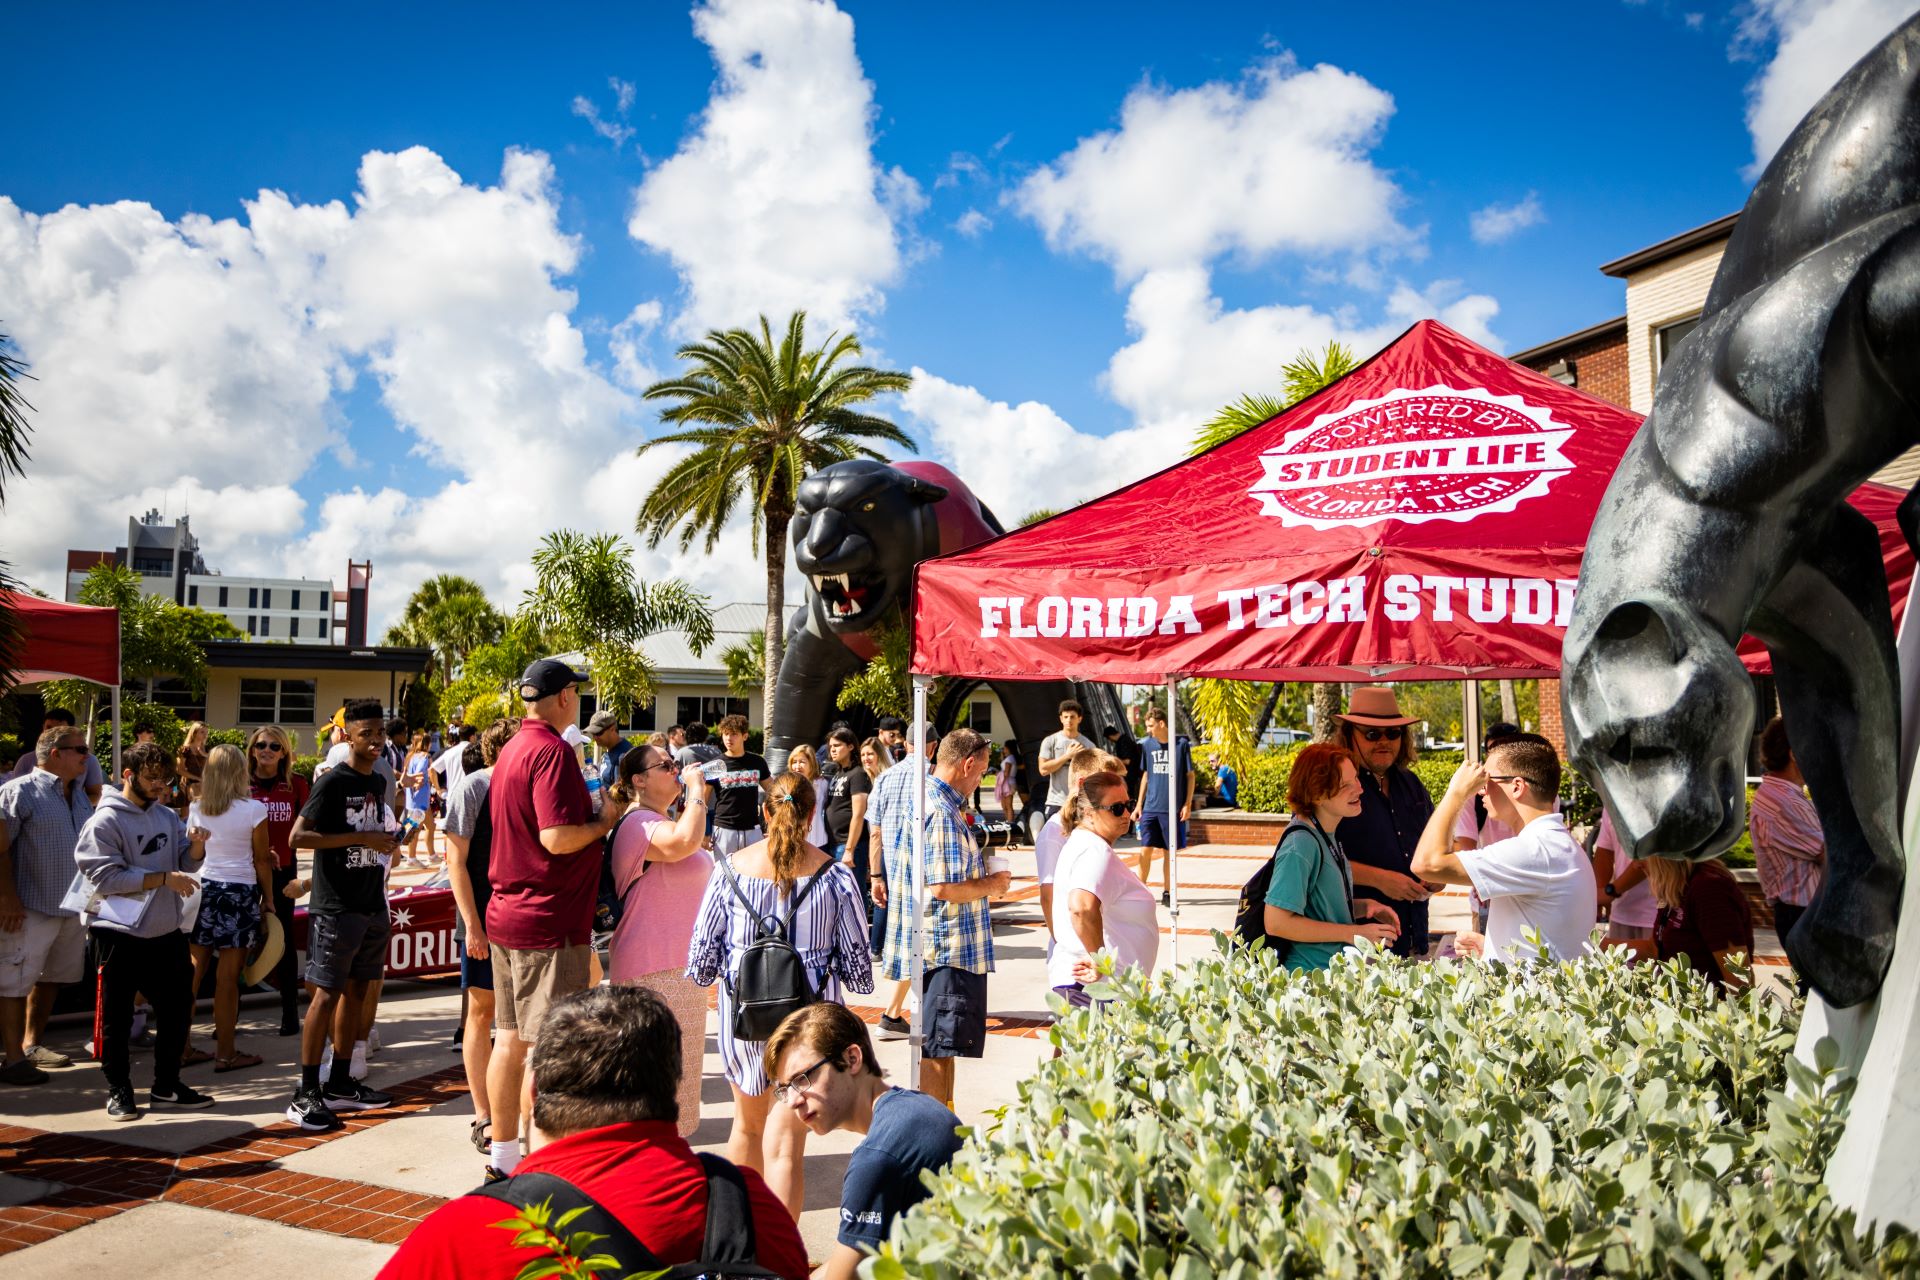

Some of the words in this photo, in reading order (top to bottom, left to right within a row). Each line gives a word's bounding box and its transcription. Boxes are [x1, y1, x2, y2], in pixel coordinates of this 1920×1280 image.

[1310, 403, 1472, 450] POWERED
[1472, 410, 1523, 433] BY
[1278, 447, 1457, 482] STUDENT
[1465, 442, 1547, 467] LIFE
[1297, 489, 1420, 513] FLORIDA
[1425, 476, 1512, 508] TECH
[979, 595, 1202, 638] FLORIDA
[1217, 575, 1367, 630] TECH
[1151, 750, 1169, 762] TEA
[269, 812, 292, 822] TECH
